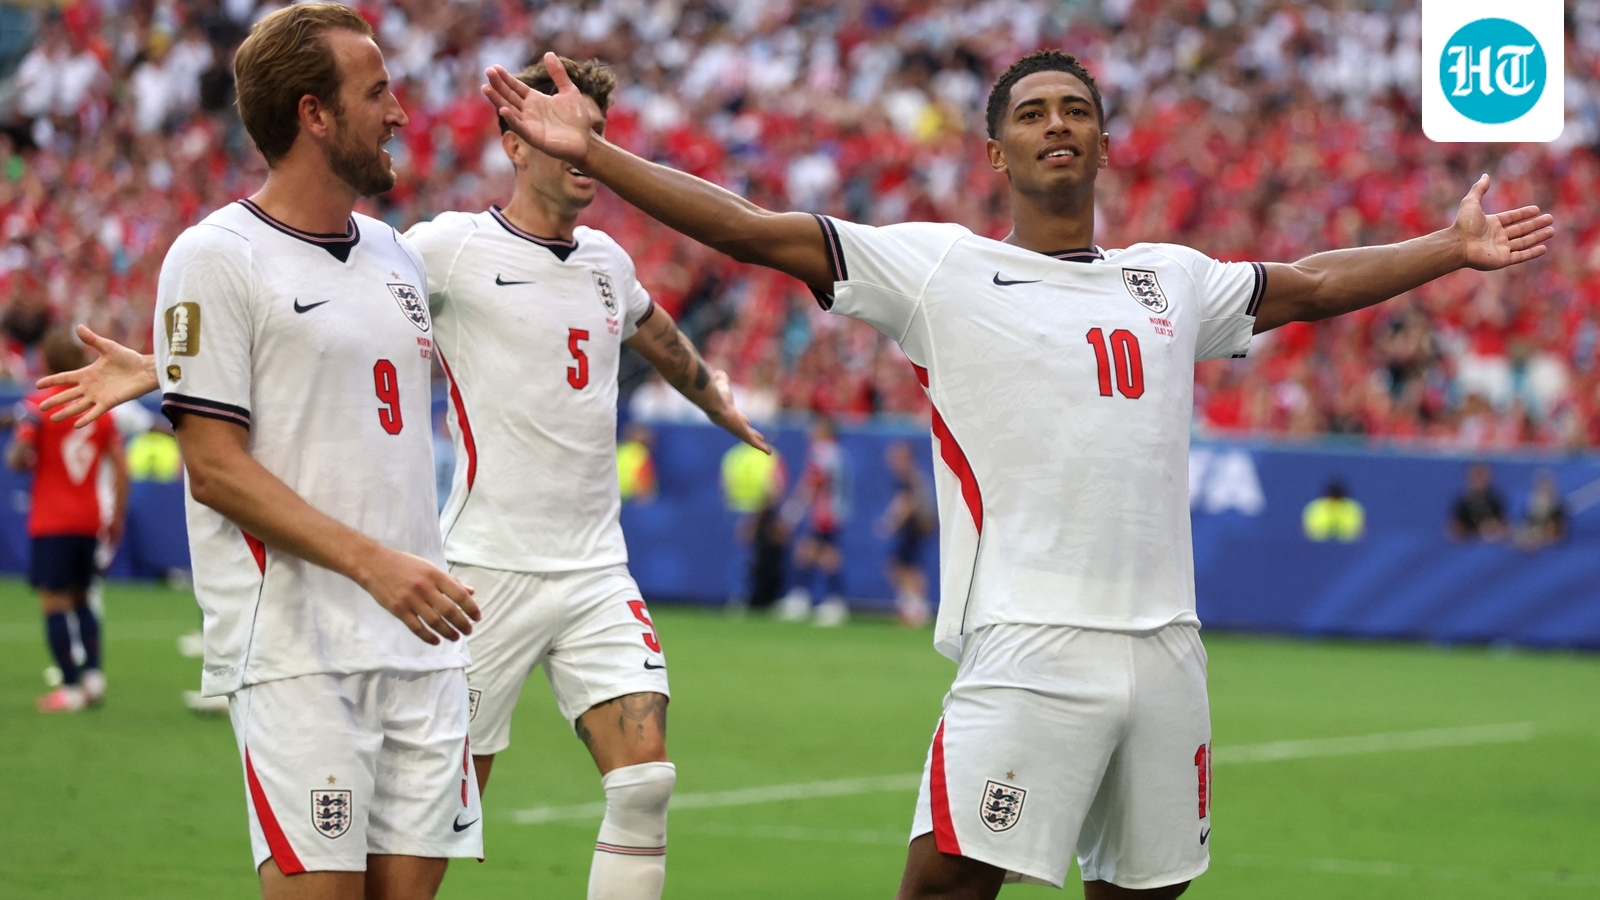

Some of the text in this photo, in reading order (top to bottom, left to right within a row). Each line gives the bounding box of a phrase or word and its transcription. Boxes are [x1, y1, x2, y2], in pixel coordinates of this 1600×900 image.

[567, 327, 589, 390] 5
[1086, 327, 1145, 399] 10
[373, 359, 403, 435] 9
[627, 600, 661, 653] 5
